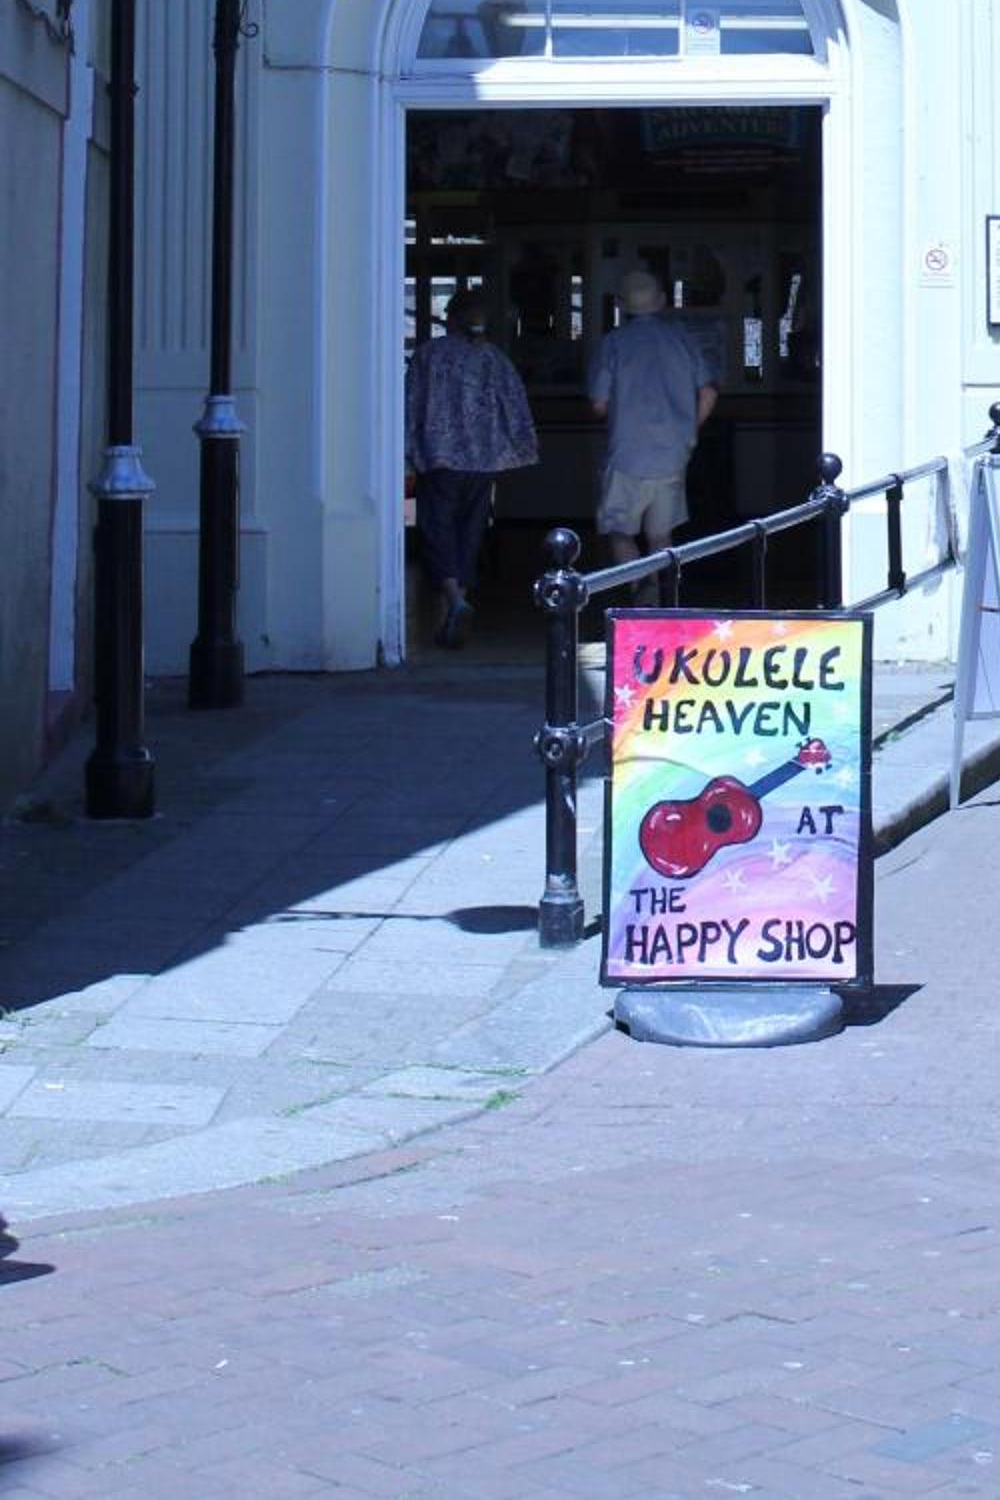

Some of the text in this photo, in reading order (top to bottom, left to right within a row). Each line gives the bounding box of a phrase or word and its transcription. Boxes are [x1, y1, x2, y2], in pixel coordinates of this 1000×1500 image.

[642, 698, 812, 737] HEAVEN
[796, 805, 844, 835] AT
[629, 886, 687, 916] THE
[624, 918, 856, 965] HAPPY SHOP
